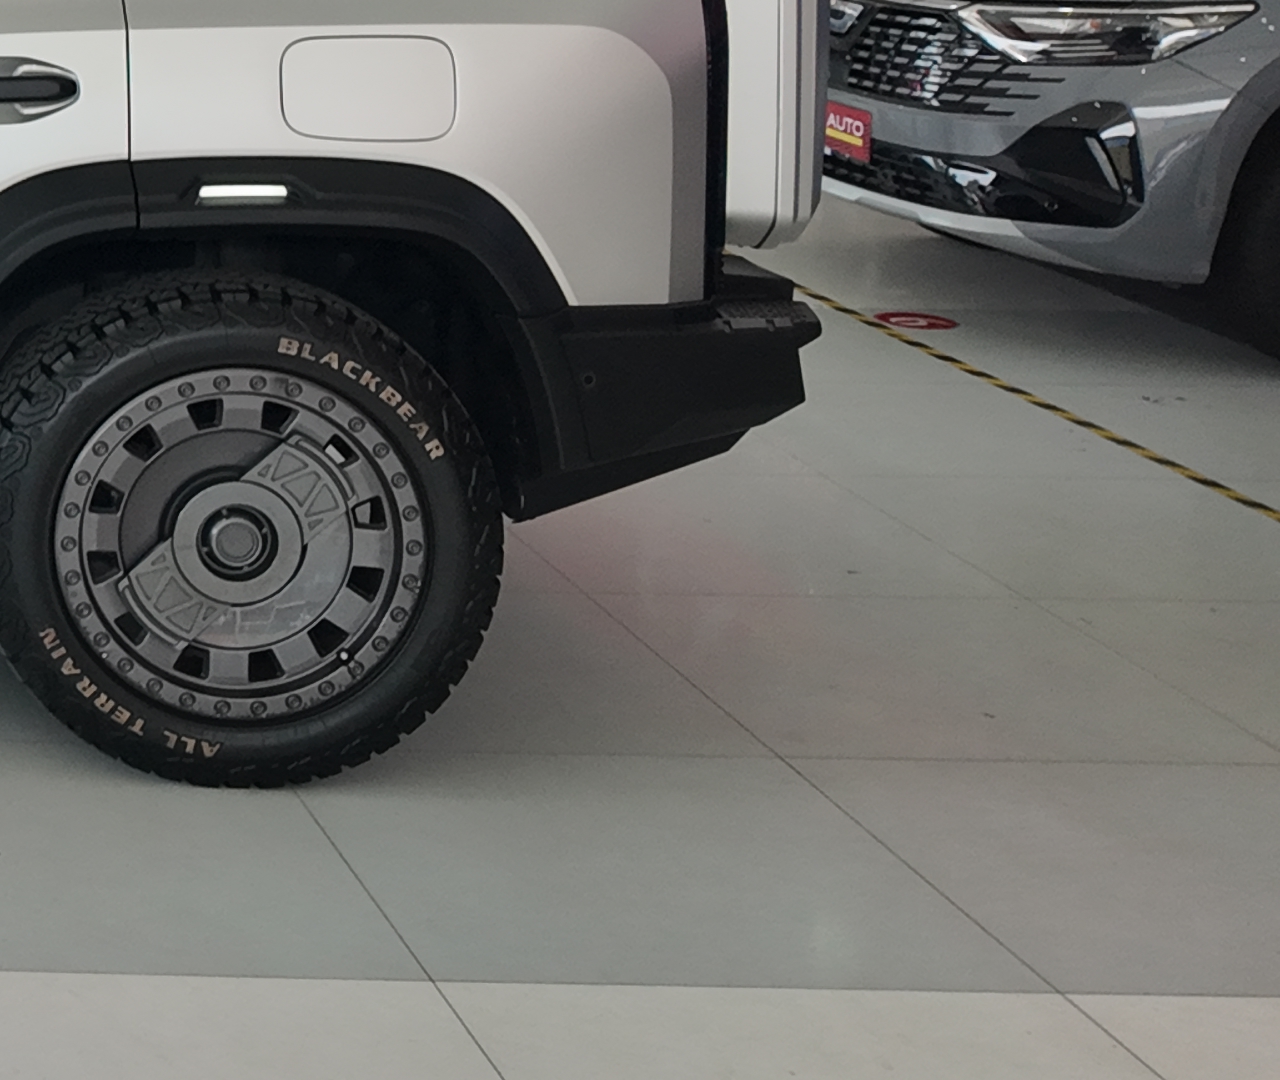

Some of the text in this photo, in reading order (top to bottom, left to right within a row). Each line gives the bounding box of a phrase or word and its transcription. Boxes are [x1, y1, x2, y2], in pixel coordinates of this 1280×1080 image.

[826, 112, 864, 137] AUTO
[277, 335, 445, 461] BLACKBEAR
[38, 626, 223, 758] ALL TERRAIN
